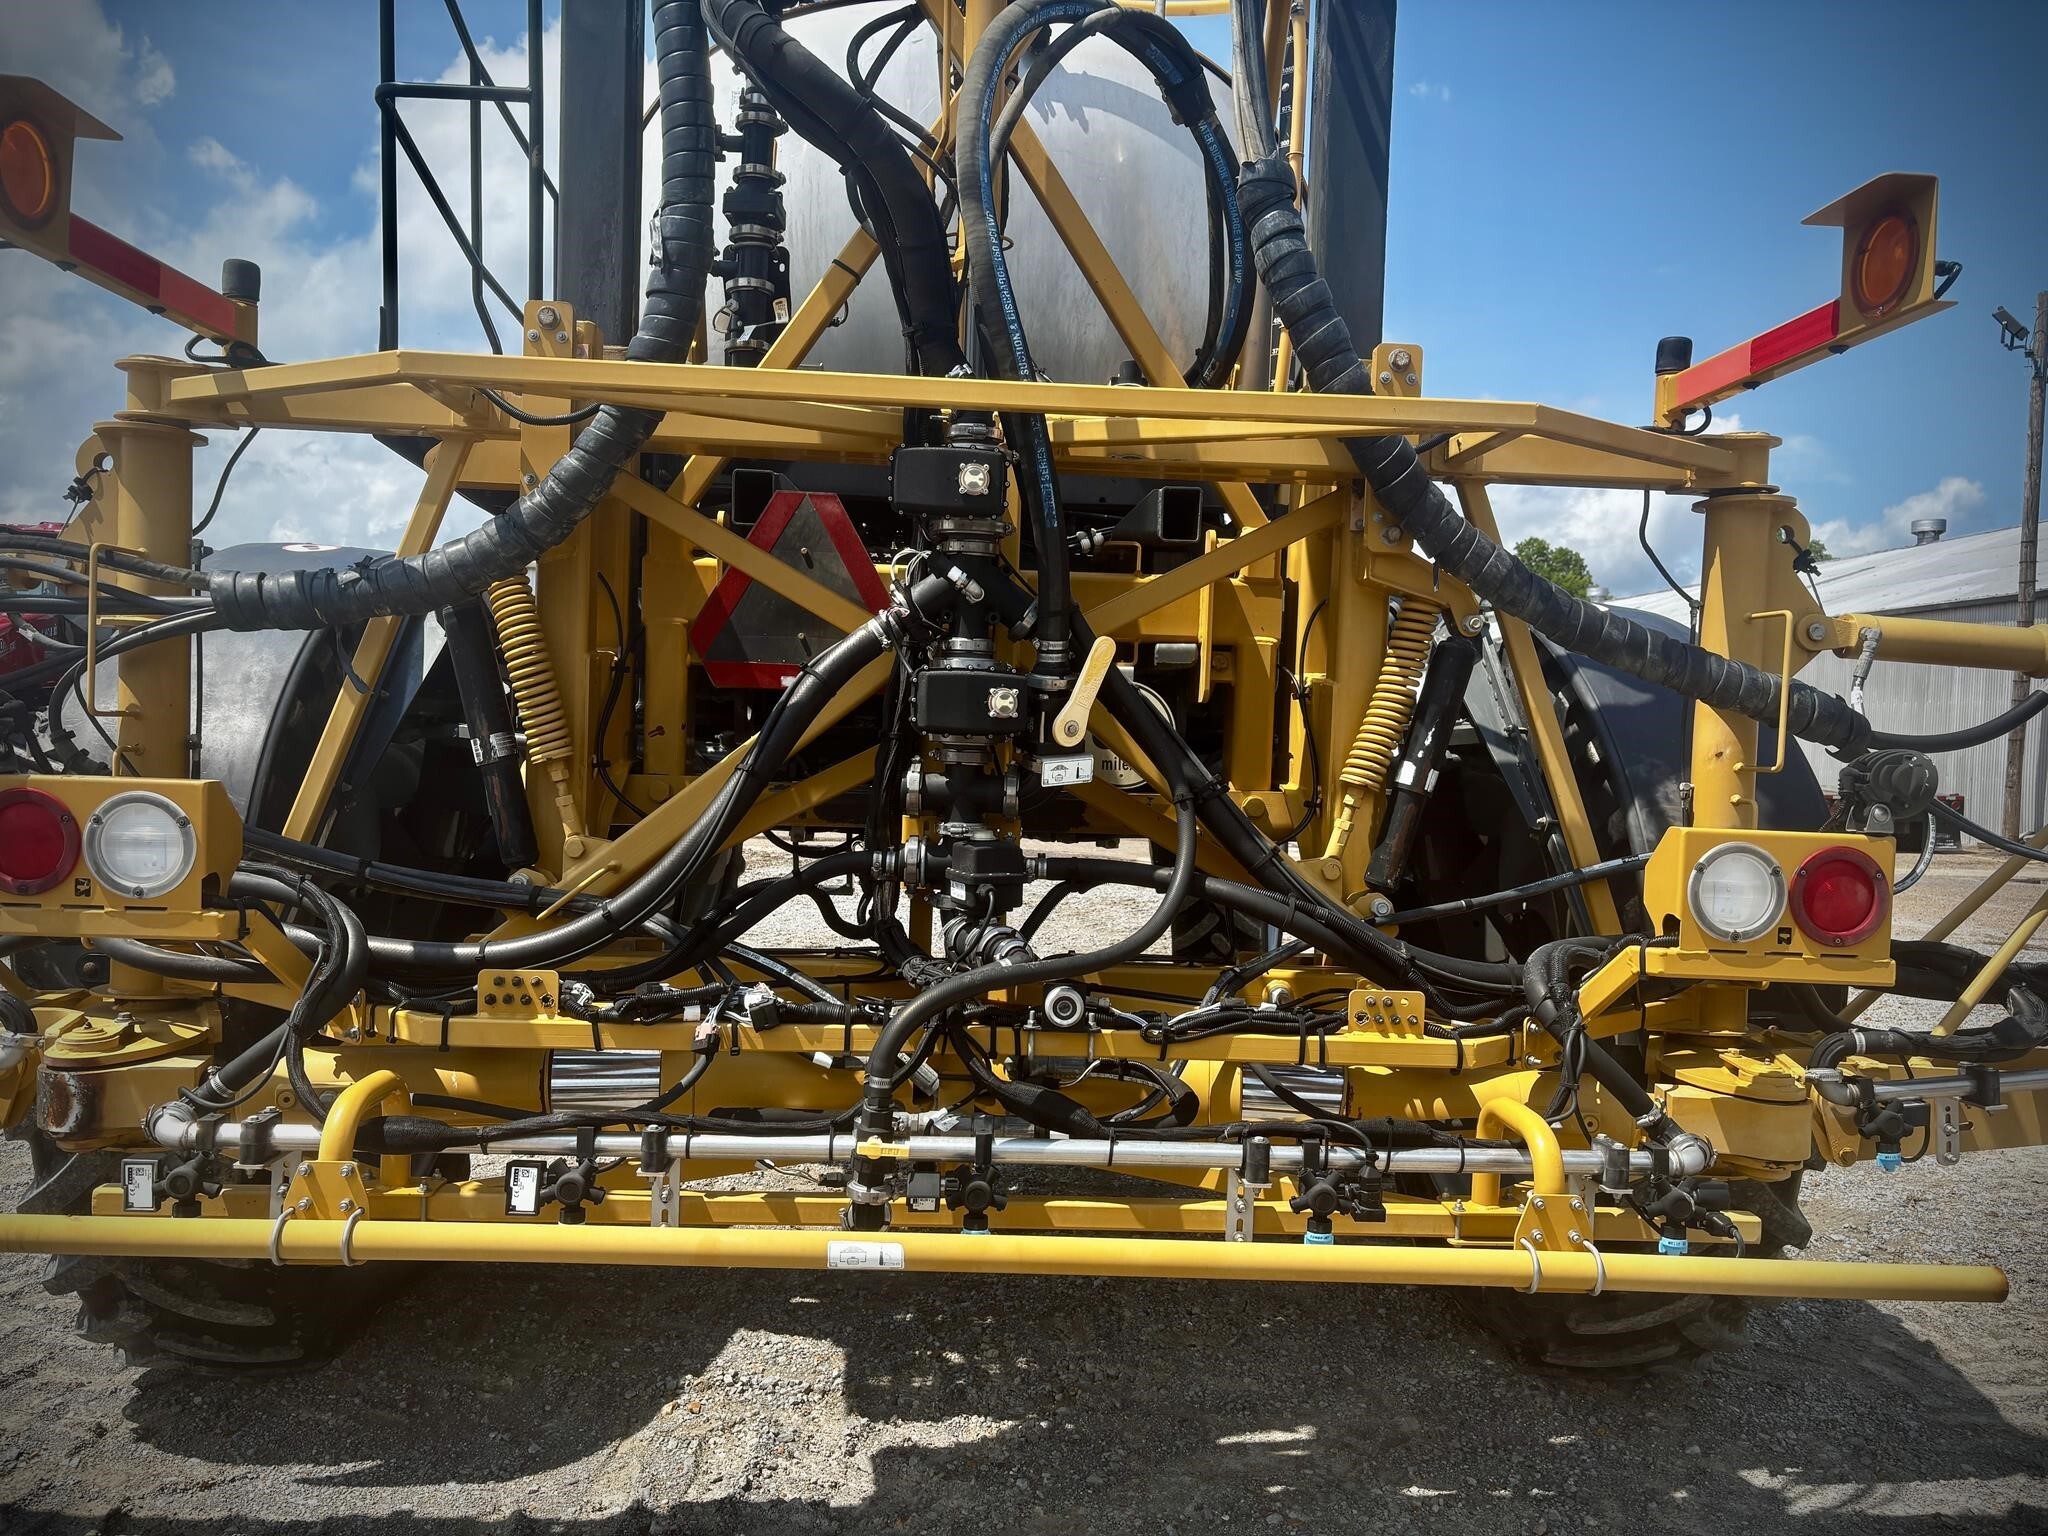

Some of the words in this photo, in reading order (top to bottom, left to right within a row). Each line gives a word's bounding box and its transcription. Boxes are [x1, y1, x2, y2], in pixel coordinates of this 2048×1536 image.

[1225, 187, 1241, 234] DISCHARGE
[1234, 253, 1243, 268] PSI
[997, 264, 1016, 320] DISCHARGE
[1013, 333, 1030, 376] SUCTION
[1101, 756, 1131, 770] mile
